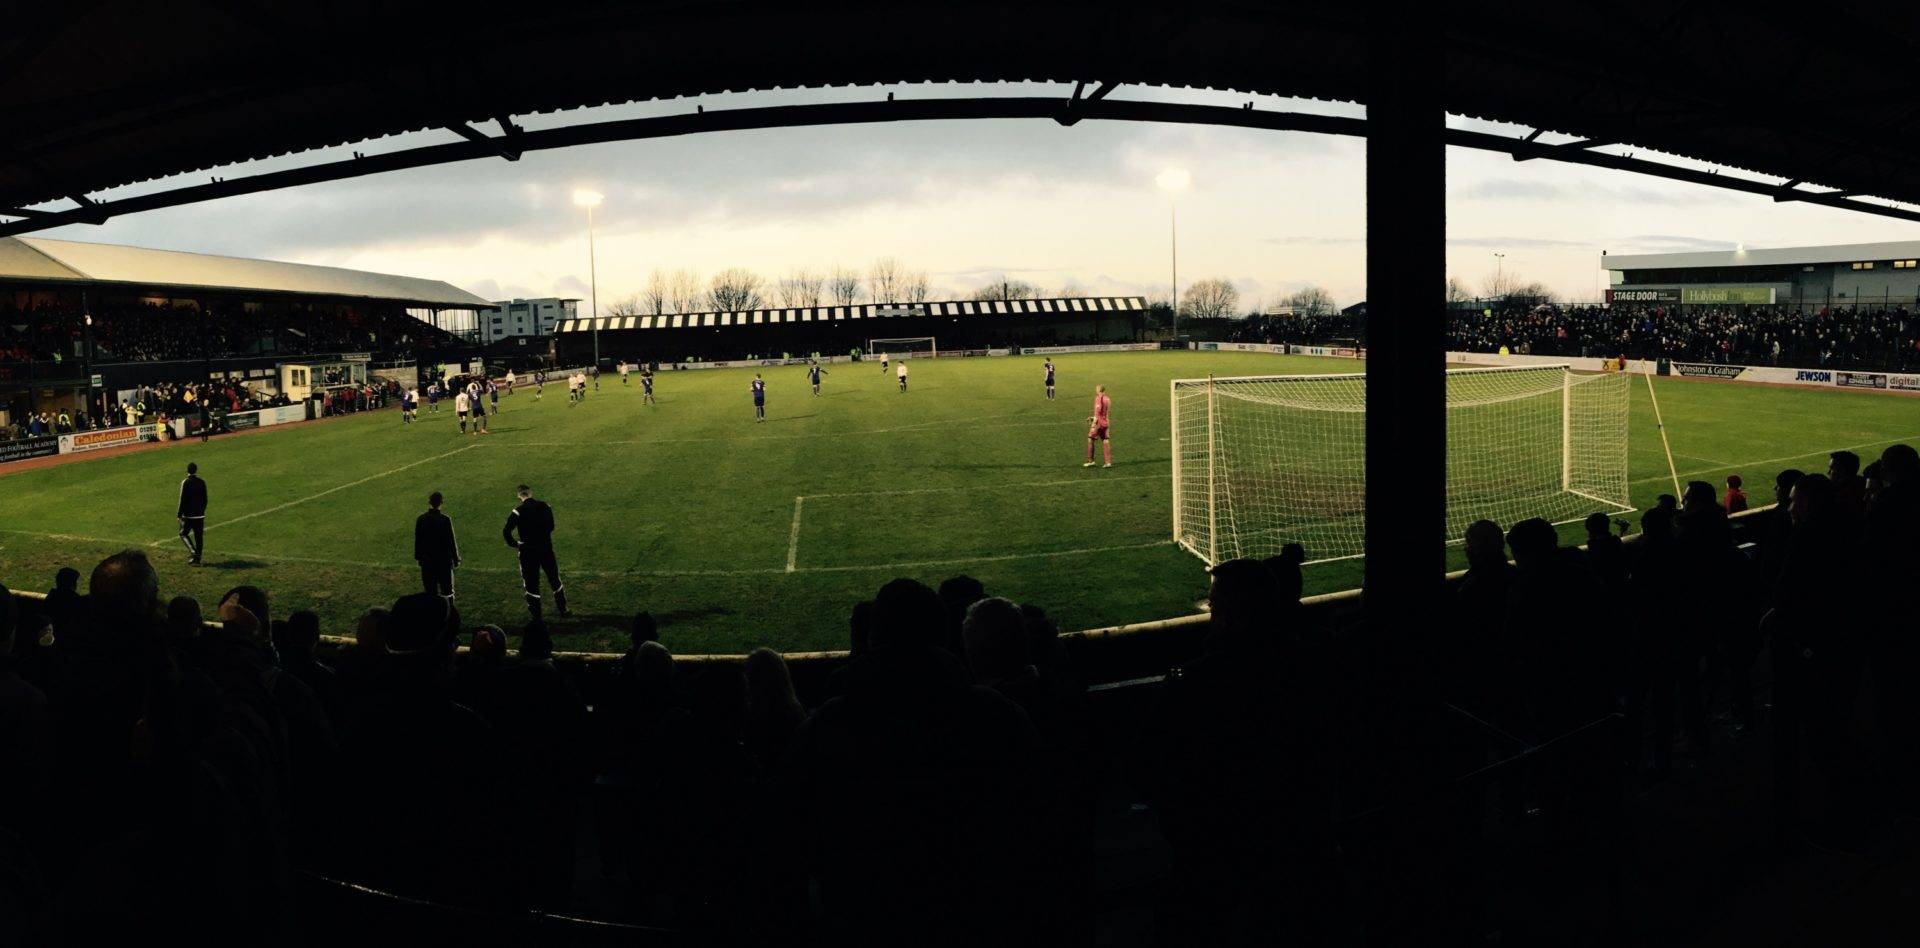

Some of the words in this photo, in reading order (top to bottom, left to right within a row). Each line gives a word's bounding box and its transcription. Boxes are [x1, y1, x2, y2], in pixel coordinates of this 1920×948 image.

[1613, 292, 1636, 300] STAGE
[1637, 292, 1658, 300] DOOR
[1690, 290, 1727, 303] Hollybush
[1678, 365, 1706, 374] Johnston
[1714, 367, 1740, 375] Graham
[1796, 371, 1831, 382] JEWSON
[1890, 377, 1919, 386] digital
[75, 430, 136, 444] Caledonian
